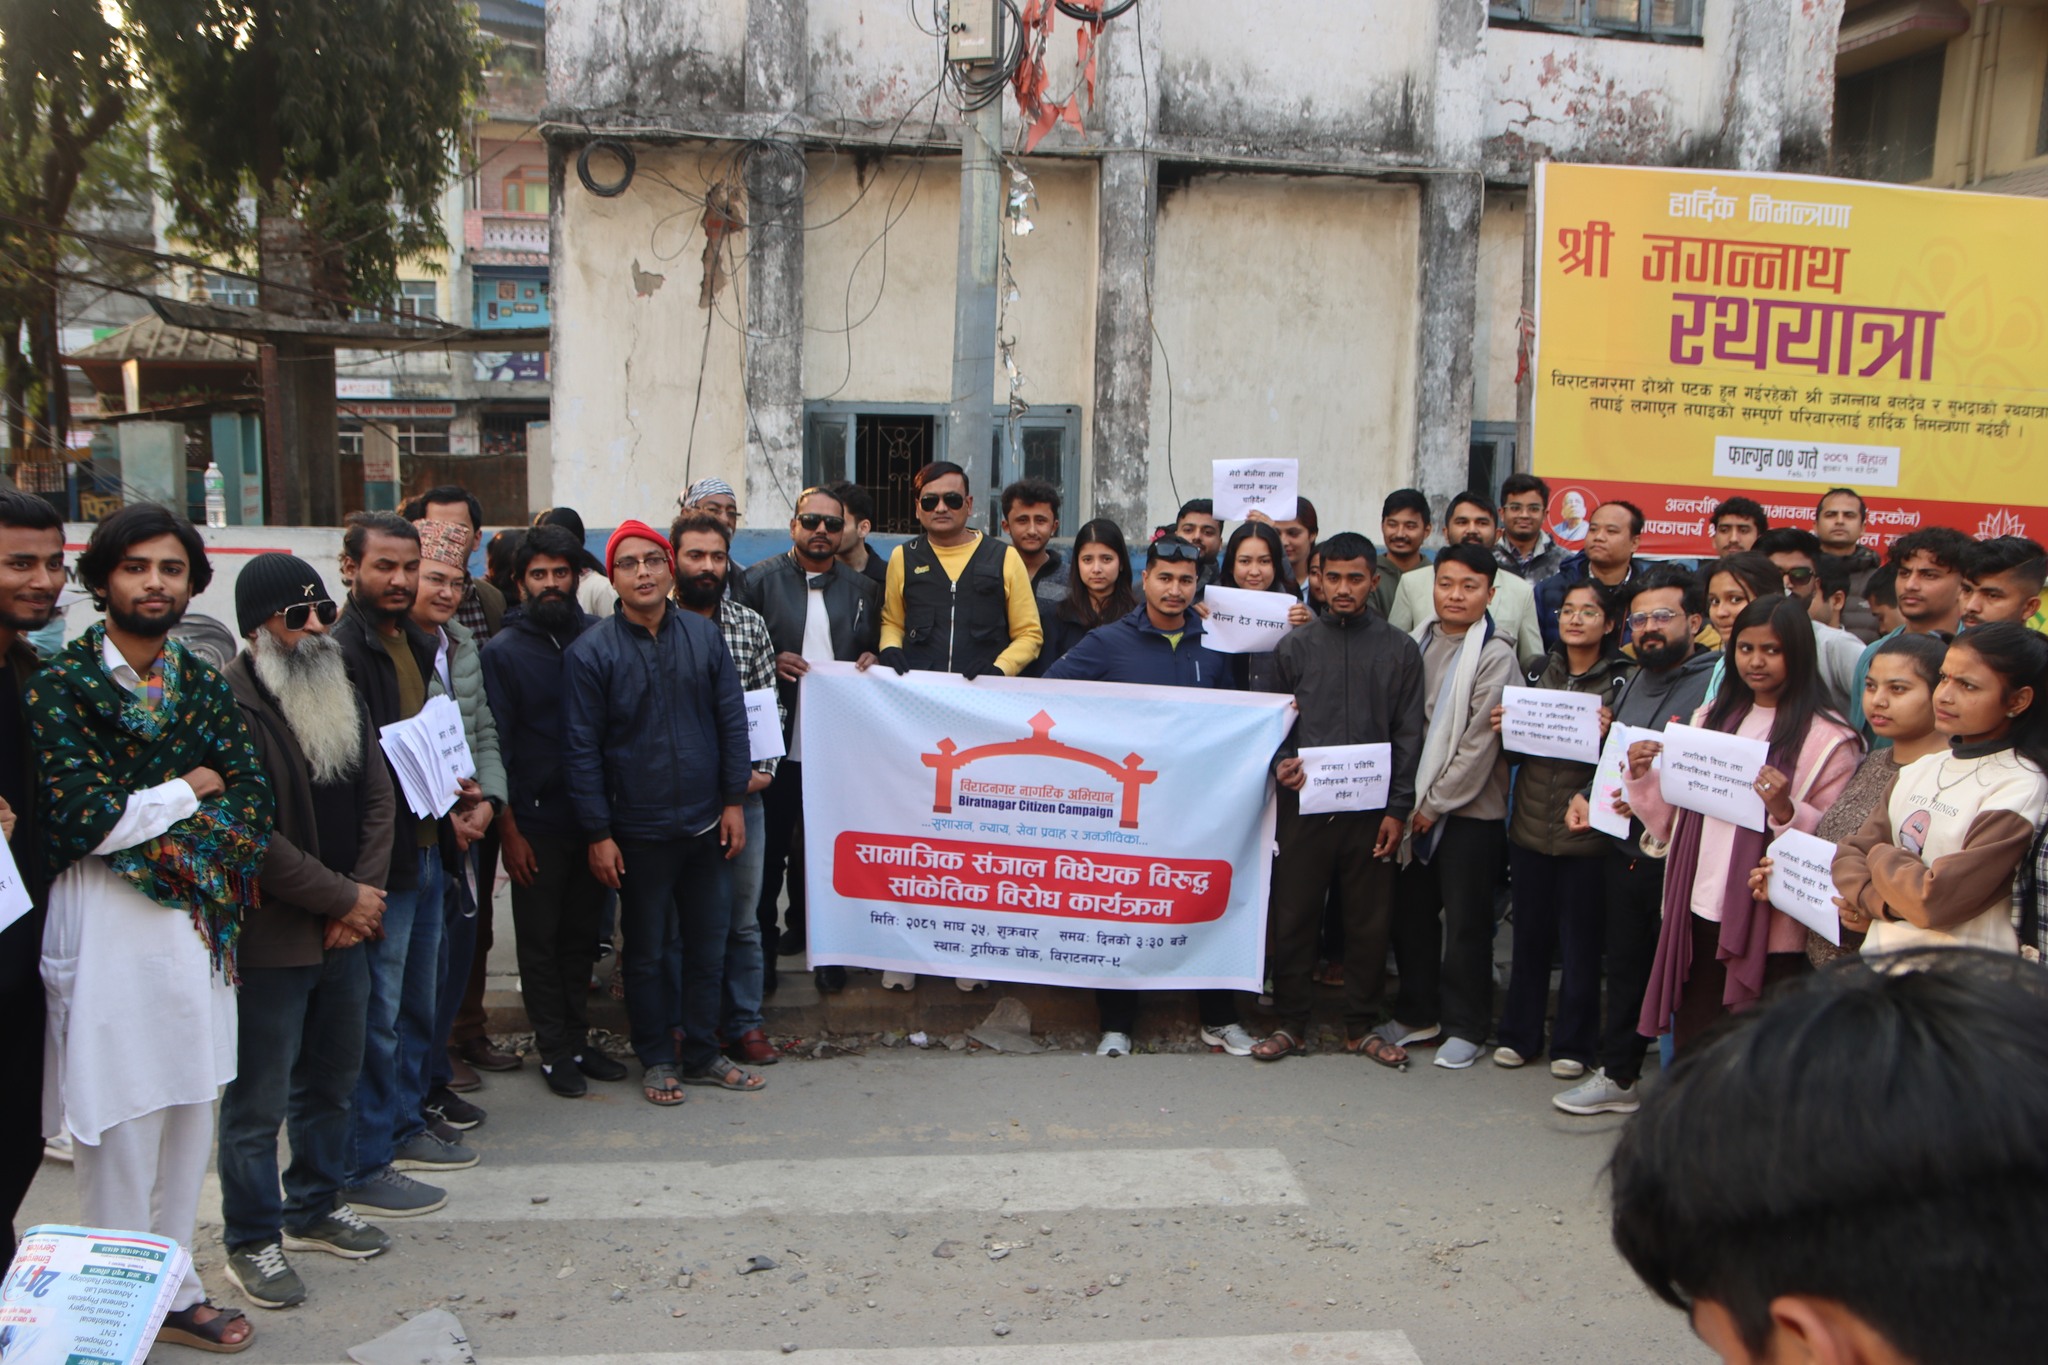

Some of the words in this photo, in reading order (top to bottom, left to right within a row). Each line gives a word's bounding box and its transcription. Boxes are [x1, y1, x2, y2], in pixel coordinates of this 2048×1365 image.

[1668, 187, 1738, 223] हार्दिक
[1558, 220, 1615, 278] श्री
[1642, 233, 1851, 294] जगन्नाथ
[1669, 292, 1946, 381] रथयात्रा
[1681, 382, 1713, 397] पटक
[1728, 445, 1774, 472] फाल्गुन
[1797, 446, 1819, 470] गते
[1212, 611, 1235, 623] बोल्न
[1238, 614, 1252, 625] देउ
[1255, 618, 1285, 630] सरकार
[1320, 762, 1344, 771] सरकार
[960, 778, 1016, 795] विराटनगर
[1019, 784, 1063, 799] नागरिक
[1067, 787, 1114, 803] अभियान
[958, 795, 1017, 812] Biratnagar
[1018, 799, 1056, 814] Citizen
[1058, 802, 1114, 819] Campaign
[1928, 800, 1960, 817] THINGS
[1016, 822, 1037, 837] सेवा
[1071, 829, 1079, 840] र
[855, 841, 965, 872] सामाजिक
[971, 852, 1046, 879] संजाल
[1054, 856, 1142, 886] विधेयक
[887, 873, 990, 904] सांकेतिक
[996, 882, 1062, 910] विरोध
[1069, 889, 1175, 918] कार्यक्रम
[905, 917, 937, 930] २०८१
[943, 920, 966, 933] माघ
[1096, 930, 1131, 947] दिनको
[1170, 934, 1187, 948] बजे
[26, 1243, 57, 1253] Services
[69, 1274, 103, 1286] Radiology
[104, 1278, 138, 1290] Advanced
[84, 1286, 98, 1294] Lab
[99, 1288, 133, 1299] Advanced
[67, 1294, 98, 1305] Physician
[99, 1297, 129, 1308] General
[69, 1303, 95, 1315] Surgery
[95, 1307, 125, 1318] General
[100, 1329, 117, 1338] ENT
[74, 1335, 113, 1347] Orthopedic
[73, 1344, 109, 1357] Psychiatry
